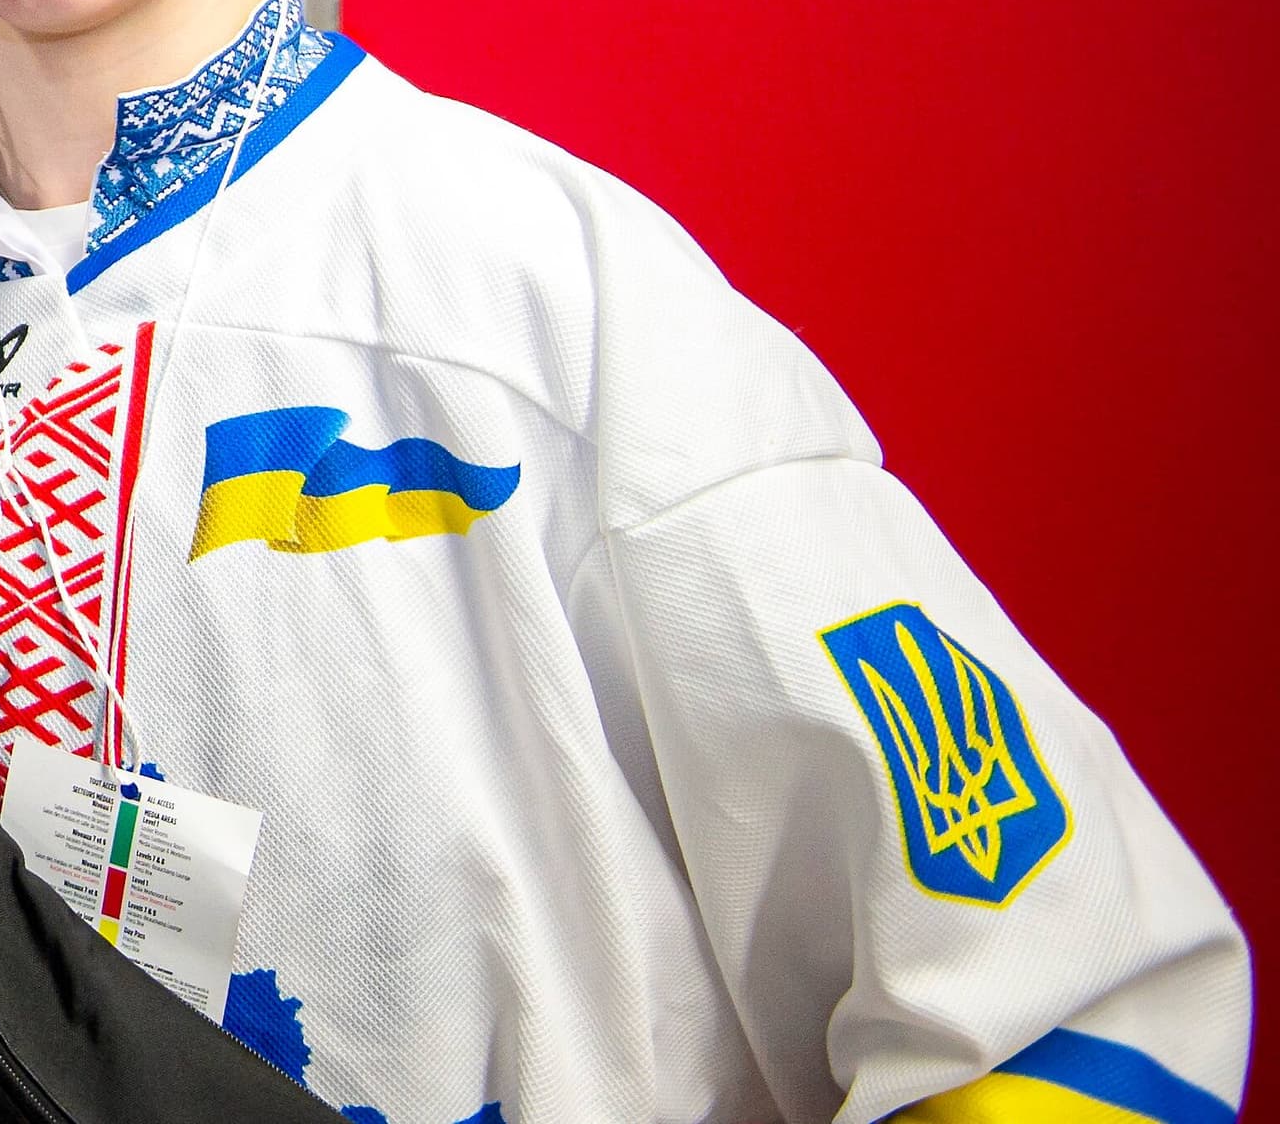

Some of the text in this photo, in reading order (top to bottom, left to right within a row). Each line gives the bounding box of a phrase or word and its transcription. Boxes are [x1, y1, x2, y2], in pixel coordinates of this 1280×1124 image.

[157, 799, 175, 810] ACCESS
[144, 809, 160, 820] MEDIA
[142, 817, 156, 826] Level
[136, 851, 152, 861] Levels
[132, 876, 145, 885] Level
[127, 901, 144, 912] Levels
[123, 927, 134, 936] Day
